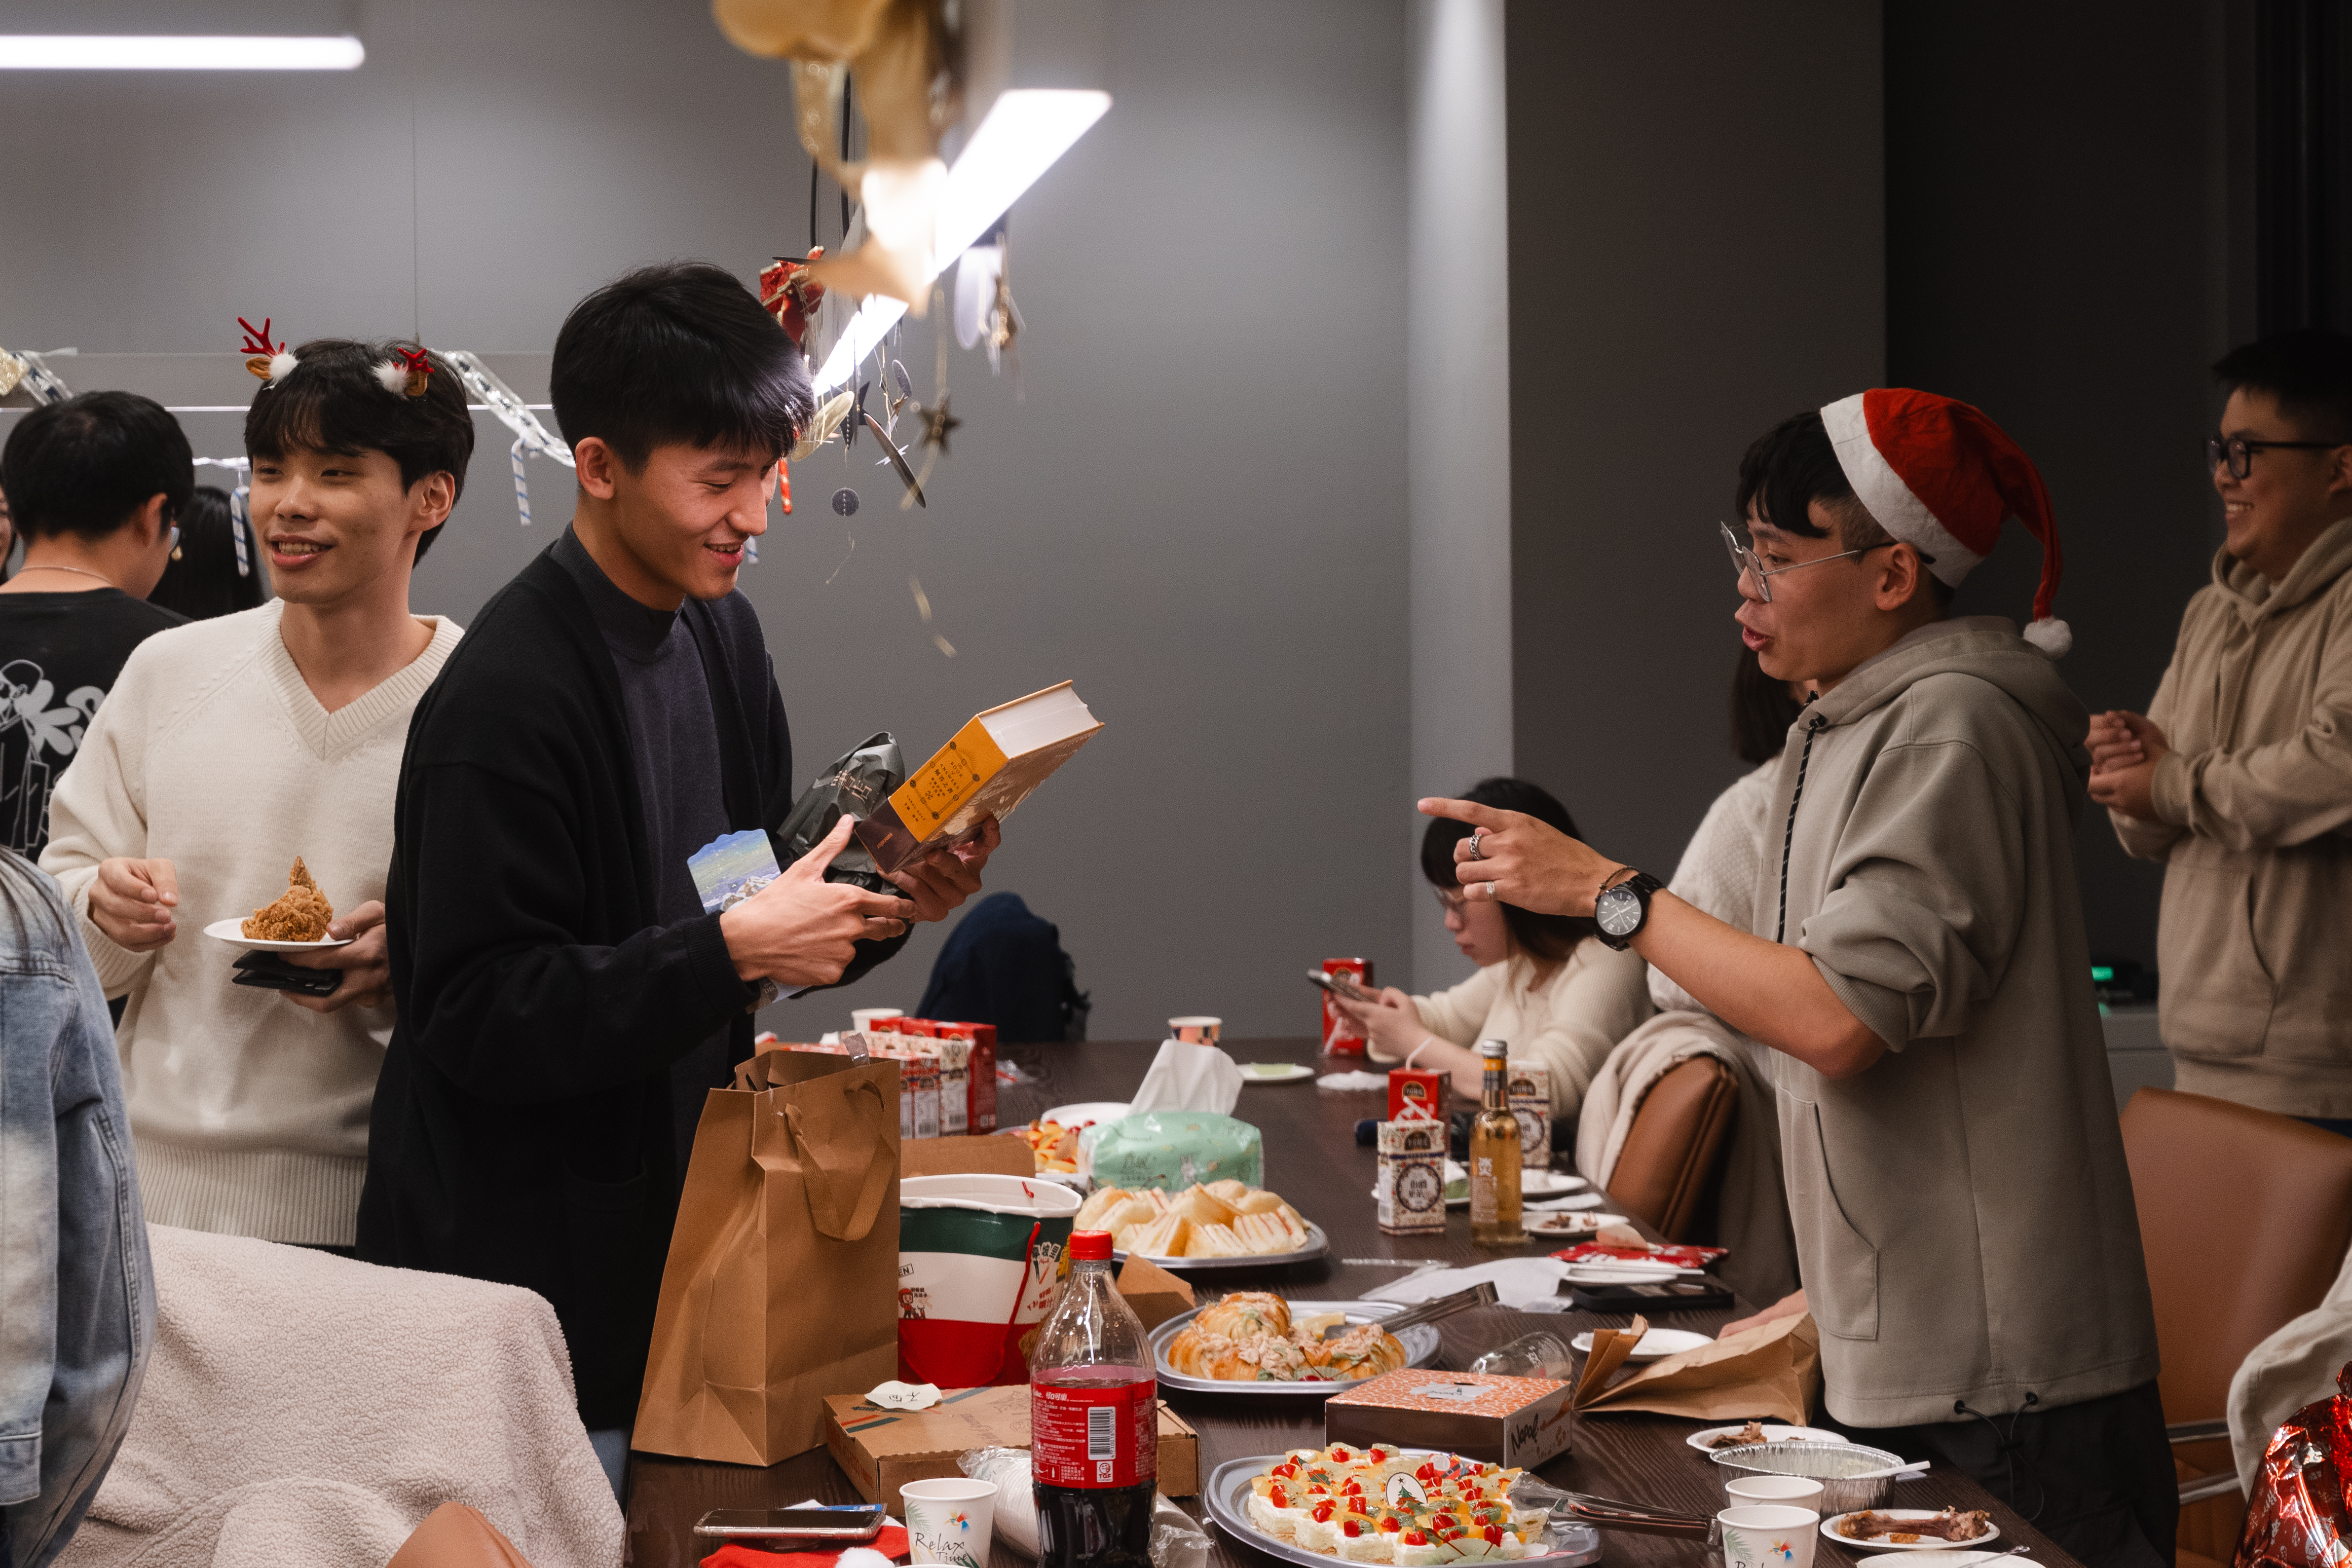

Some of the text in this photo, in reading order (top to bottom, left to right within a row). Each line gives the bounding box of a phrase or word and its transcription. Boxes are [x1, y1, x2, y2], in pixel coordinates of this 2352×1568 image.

[940, 763, 959, 790] ANSWERS
[951, 761, 963, 778] BOOK
[915, 1532, 964, 1555] Relax
[936, 1551, 968, 1562] Time
